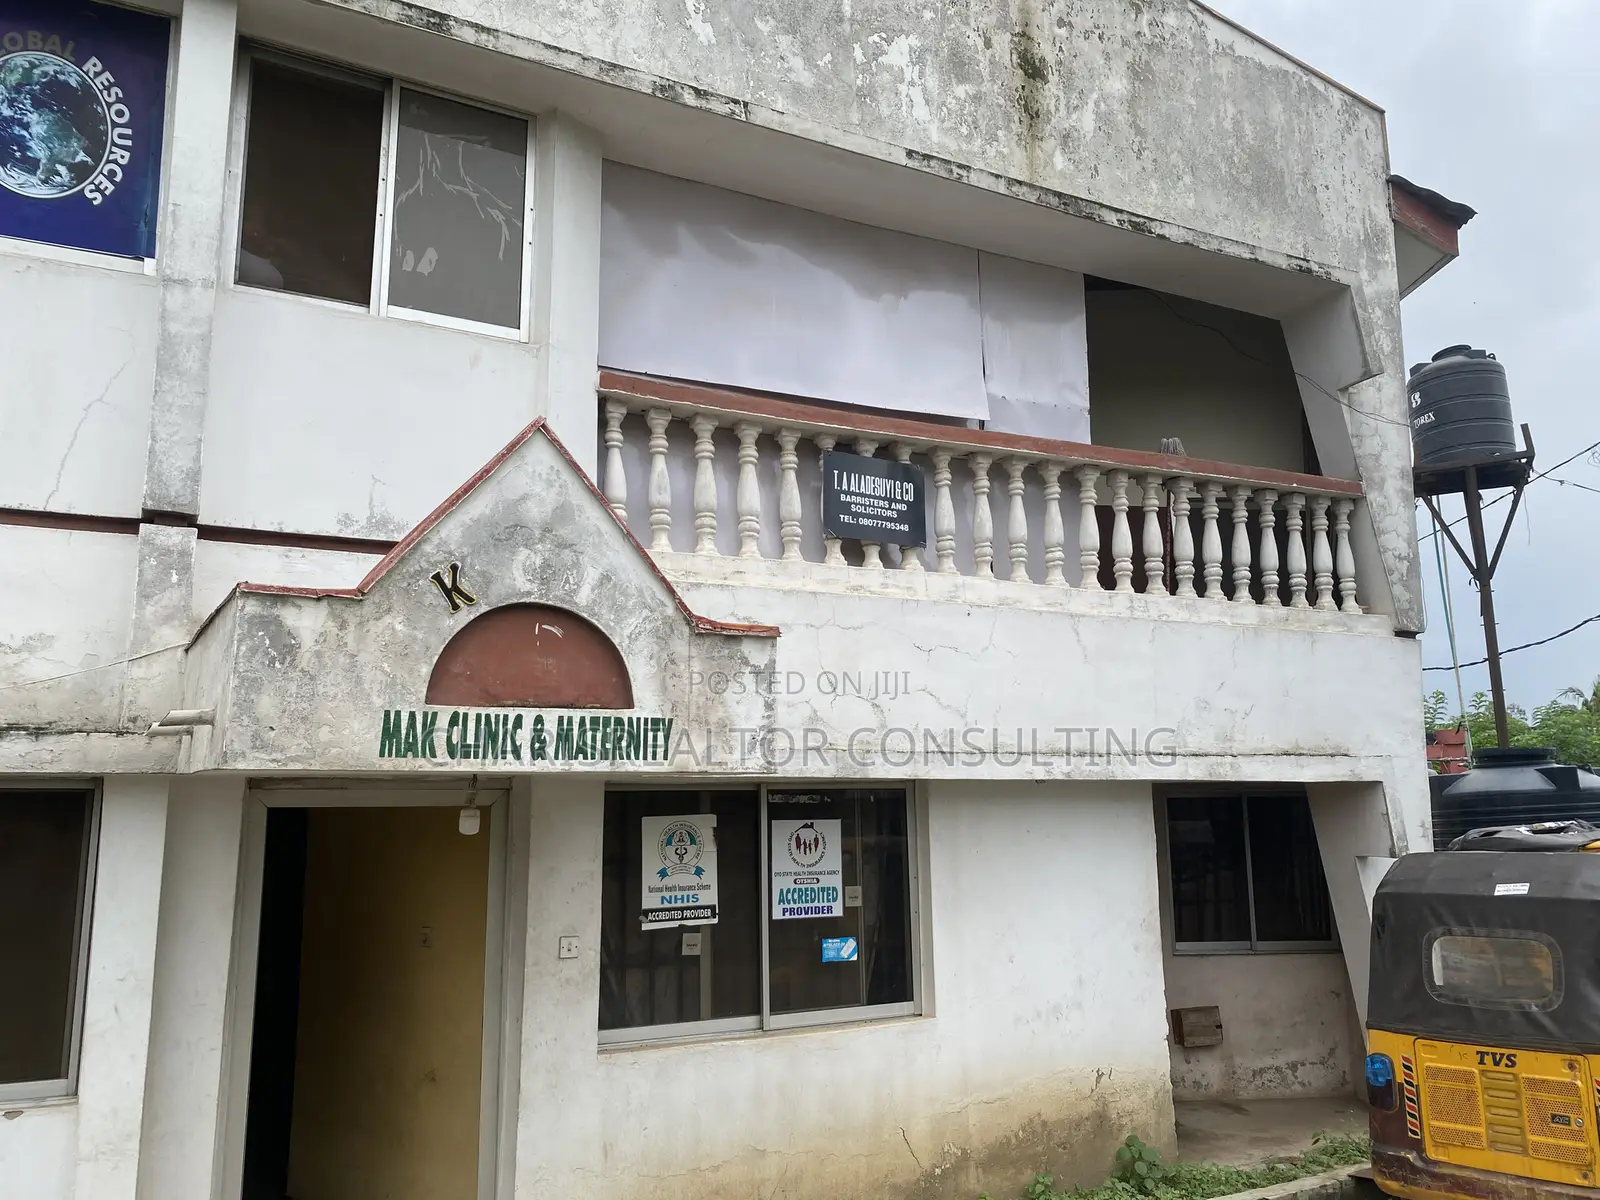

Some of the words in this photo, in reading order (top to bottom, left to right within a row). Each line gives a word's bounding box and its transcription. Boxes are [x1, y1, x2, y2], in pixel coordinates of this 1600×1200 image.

[82, 55, 133, 206] RESOURCES
[842, 472, 848, 491] A
[850, 473, 894, 499] ALADESUYI
[895, 481, 901, 500] &
[903, 482, 914, 502] CO
[840, 494, 889, 508] BARRISTERS
[891, 502, 907, 511] AND
[851, 504, 898, 518] SOLICITORS
[839, 515, 857, 524] TEL:
[858, 517, 909, 532] 08077795348
[428, 561, 478, 615] K
[379, 709, 438, 759] MAK
[446, 710, 523, 761] CLINIC
[530, 714, 548, 761] &
[554, 715, 674, 761] MATERNITY
[660, 893, 700, 905] NHIS
[778, 886, 839, 905] ACCREDITED
[648, 910, 682, 920] ACCREDITED
[683, 908, 711, 918] PROVIDER
[782, 905, 833, 917] PROVIDER
[1476, 1050, 1517, 1068] TVS
